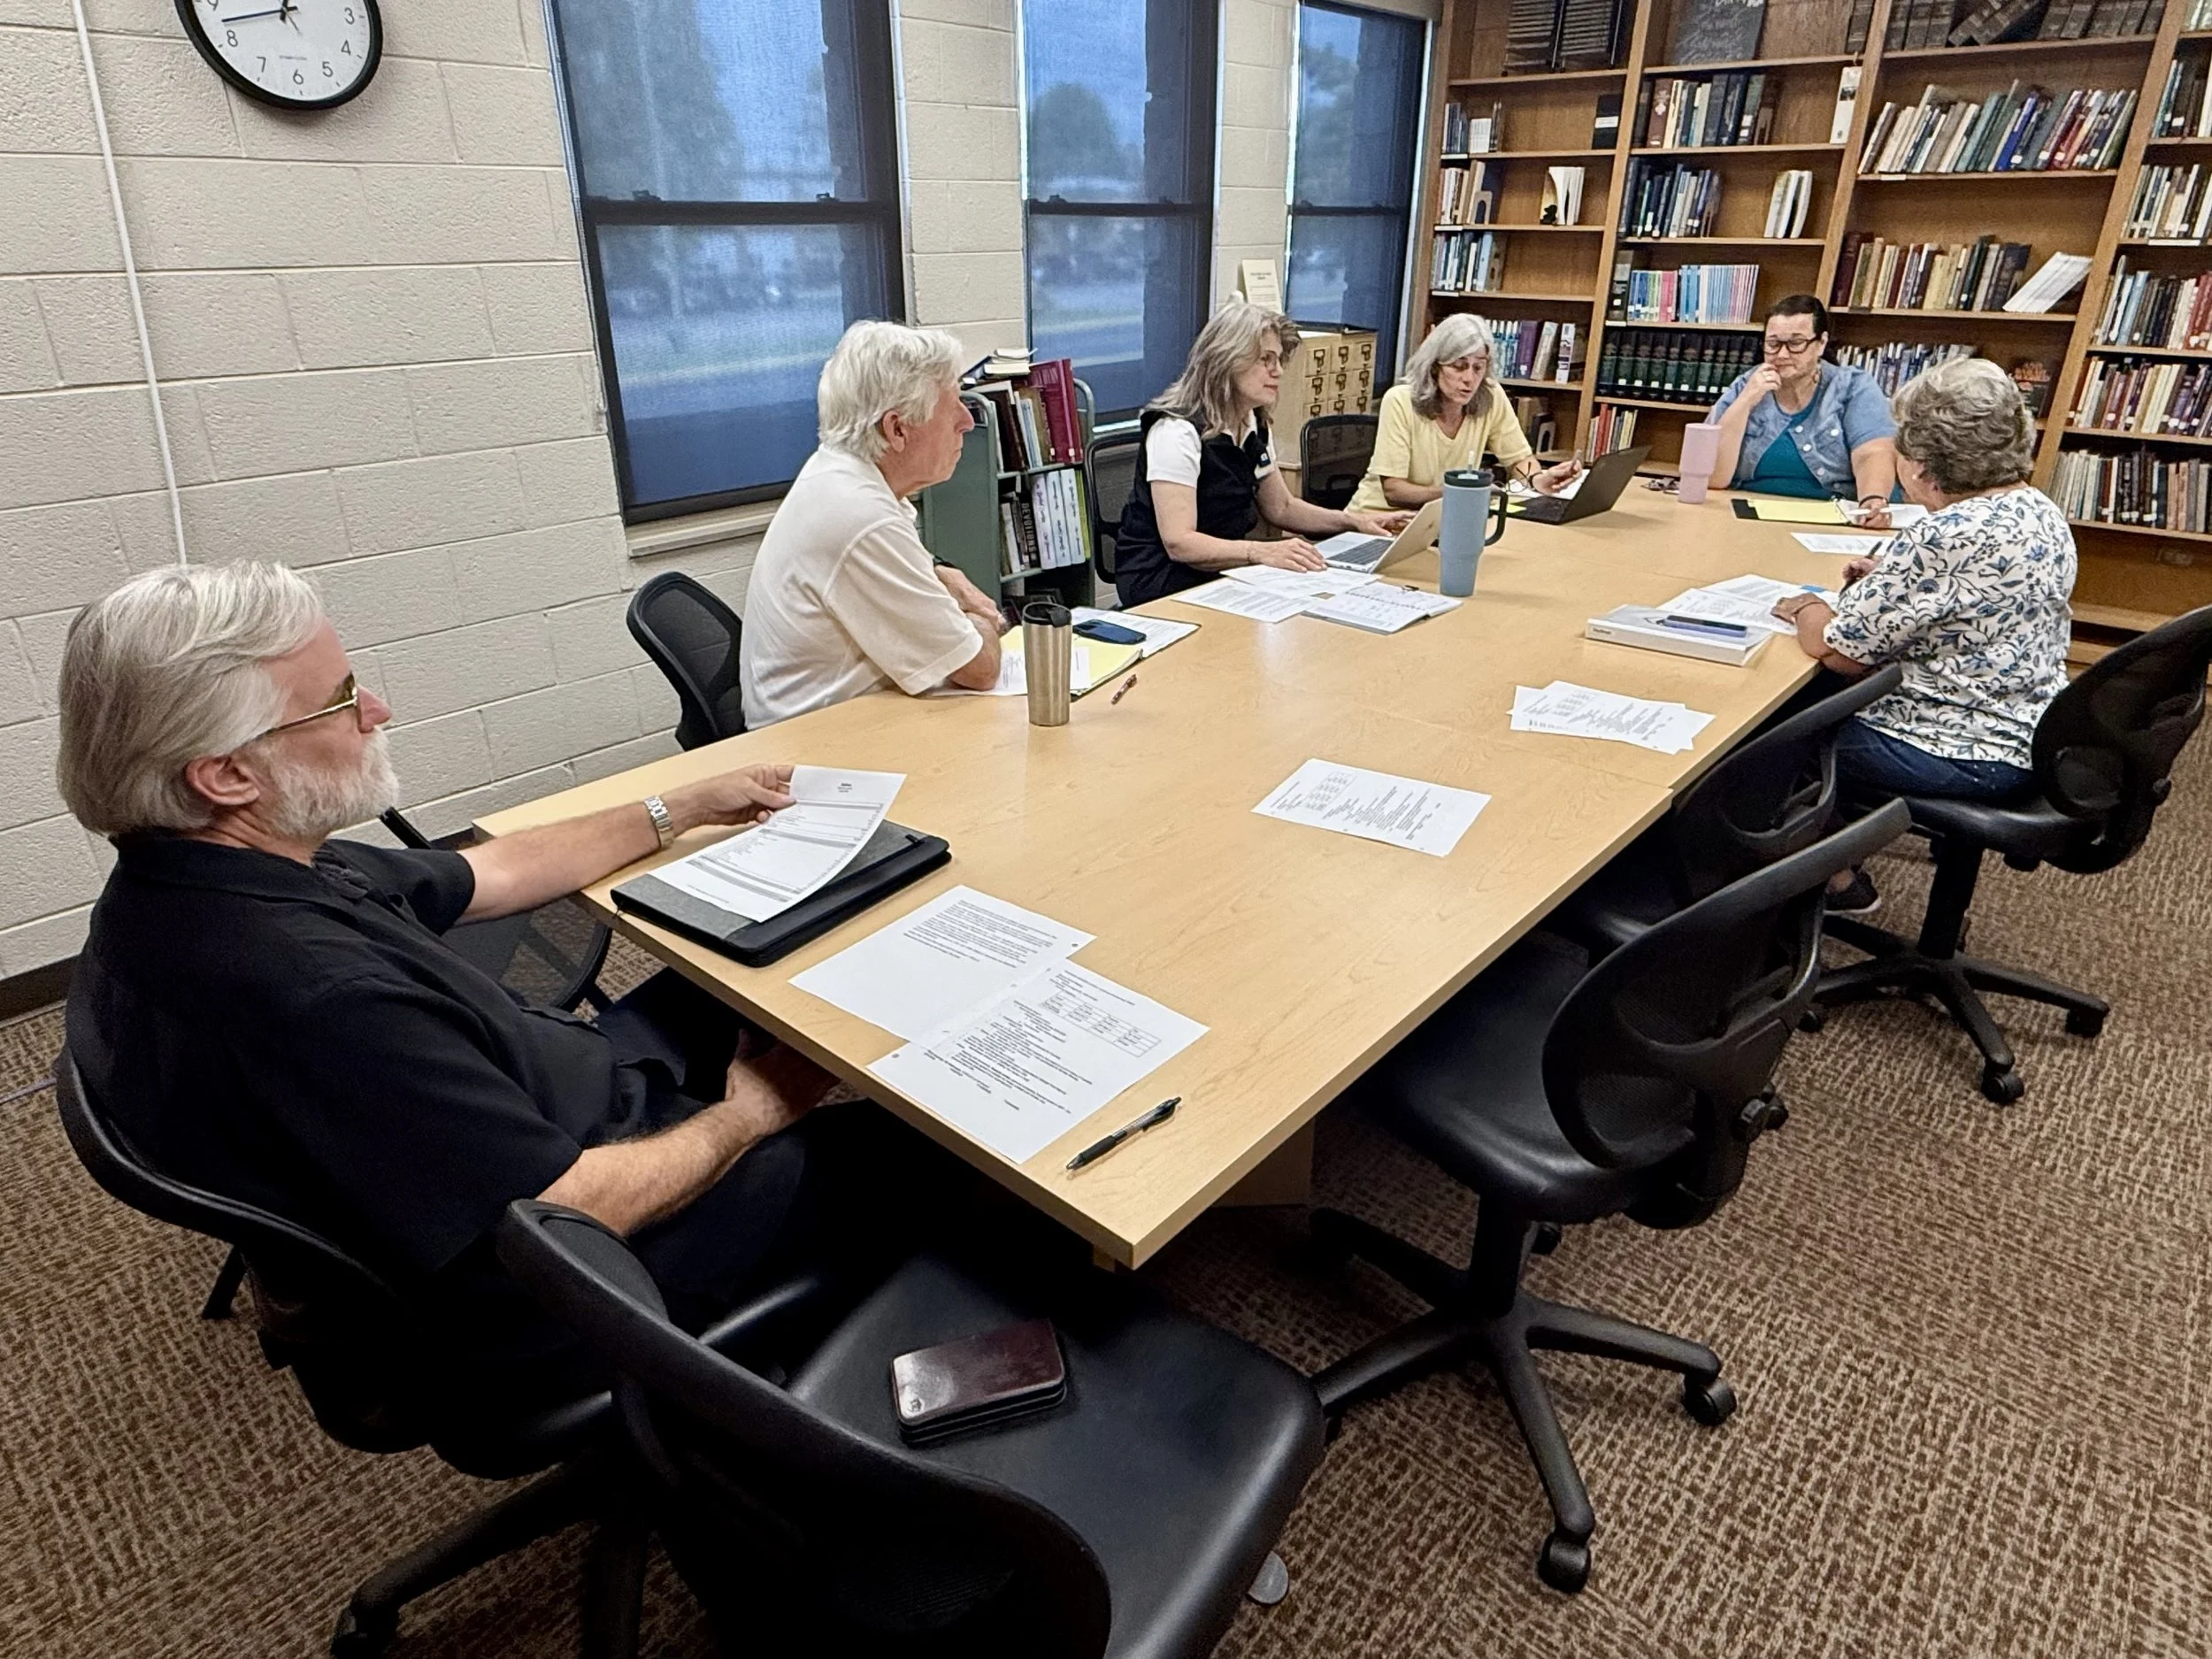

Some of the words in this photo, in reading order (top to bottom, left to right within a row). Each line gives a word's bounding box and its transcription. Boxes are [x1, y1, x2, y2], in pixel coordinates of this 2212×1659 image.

[344, 7, 355, 25] 3
[227, 30, 238, 48] 8
[341, 40, 351, 56] 4
[257, 57, 266, 73] 7
[322, 61, 334, 78] 5
[293, 69, 303, 85] 6
